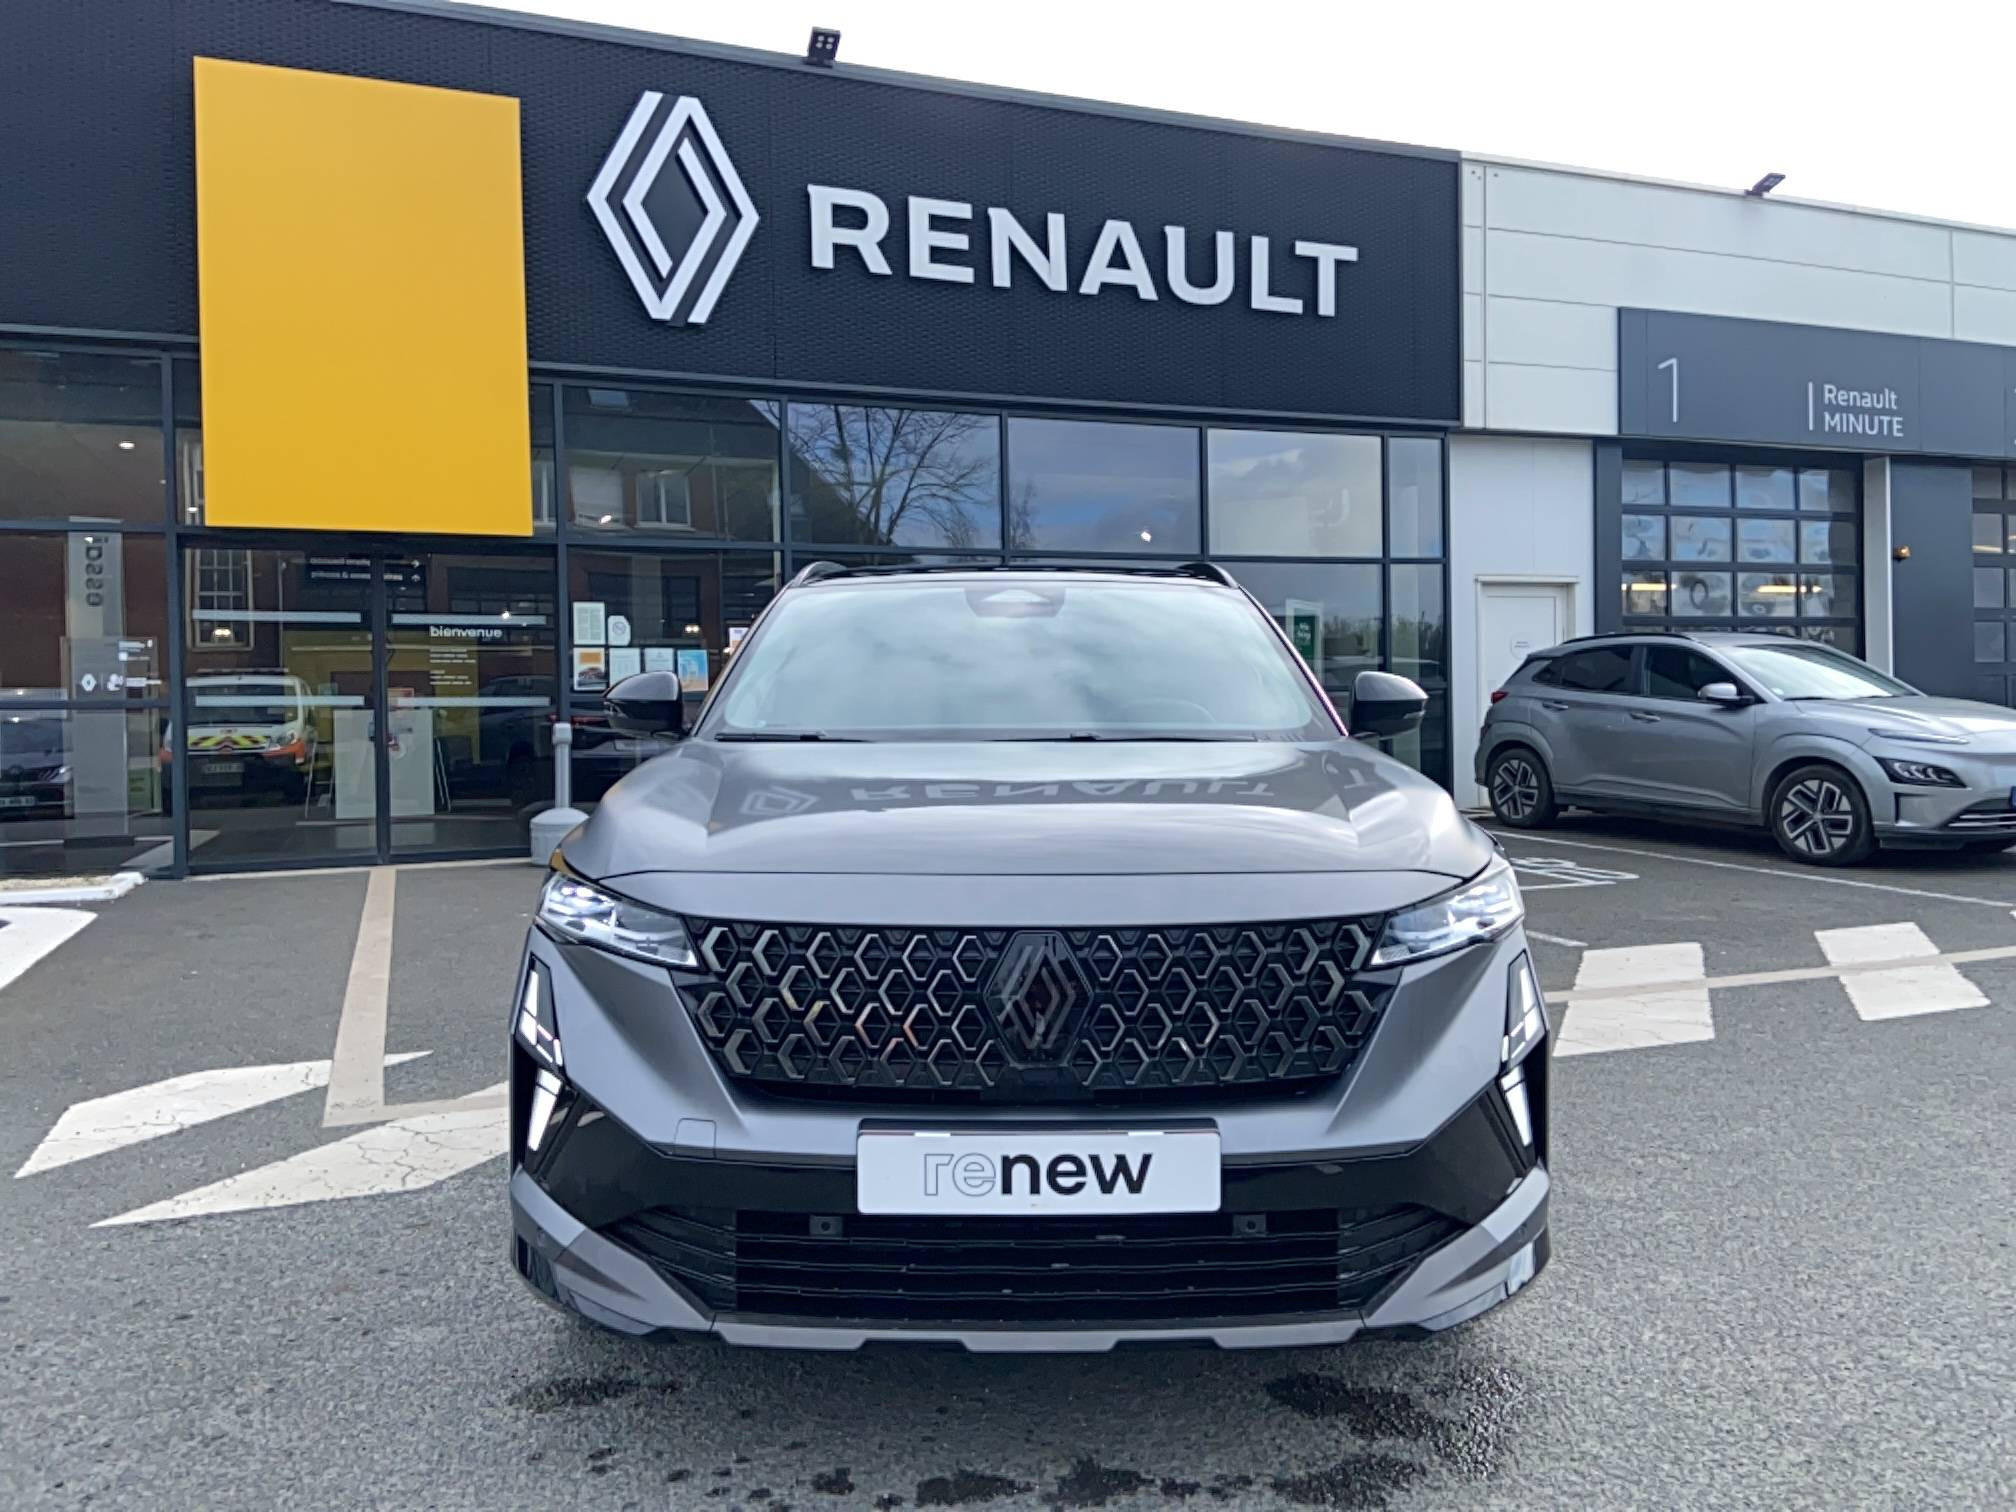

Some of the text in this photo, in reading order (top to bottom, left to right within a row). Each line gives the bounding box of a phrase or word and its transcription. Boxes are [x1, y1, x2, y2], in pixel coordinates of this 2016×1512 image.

[807, 184, 1358, 317] RENAULT
[1657, 358, 1678, 423] 1
[1823, 384, 1898, 410] Renault
[1823, 411, 1904, 437] MINUTE
[429, 625, 503, 638] bienvenue
[923, 1152, 1154, 1197] renew
